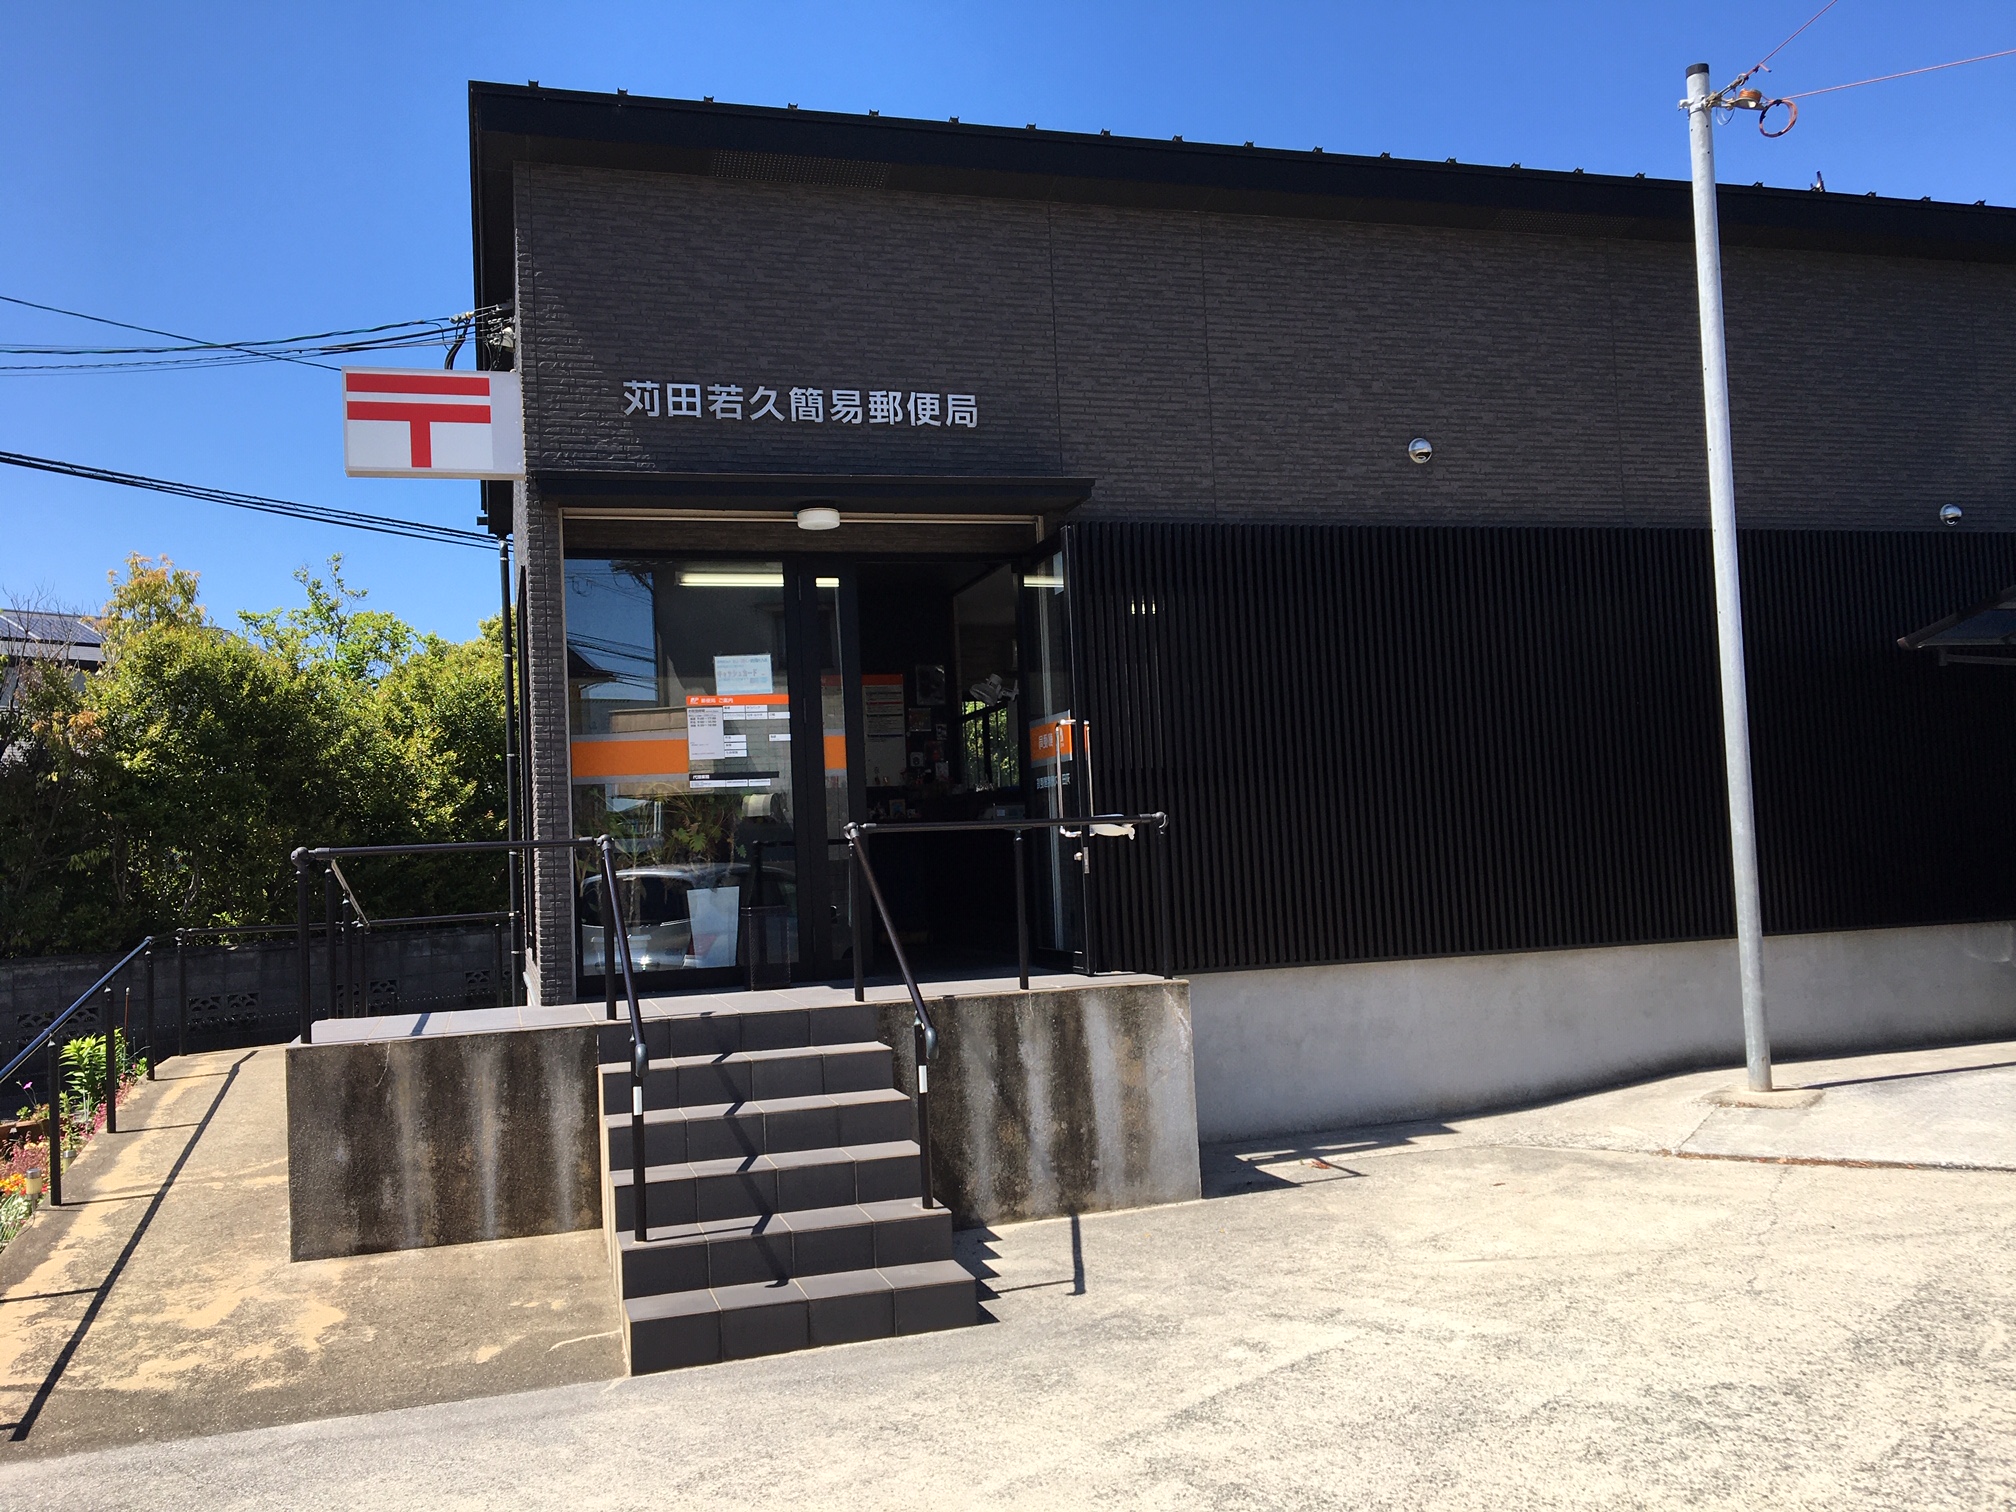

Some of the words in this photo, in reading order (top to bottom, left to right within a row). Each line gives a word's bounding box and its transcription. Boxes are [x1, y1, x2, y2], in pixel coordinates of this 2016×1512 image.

[622, 380, 978, 428] 苅田若久簡易郵便局
